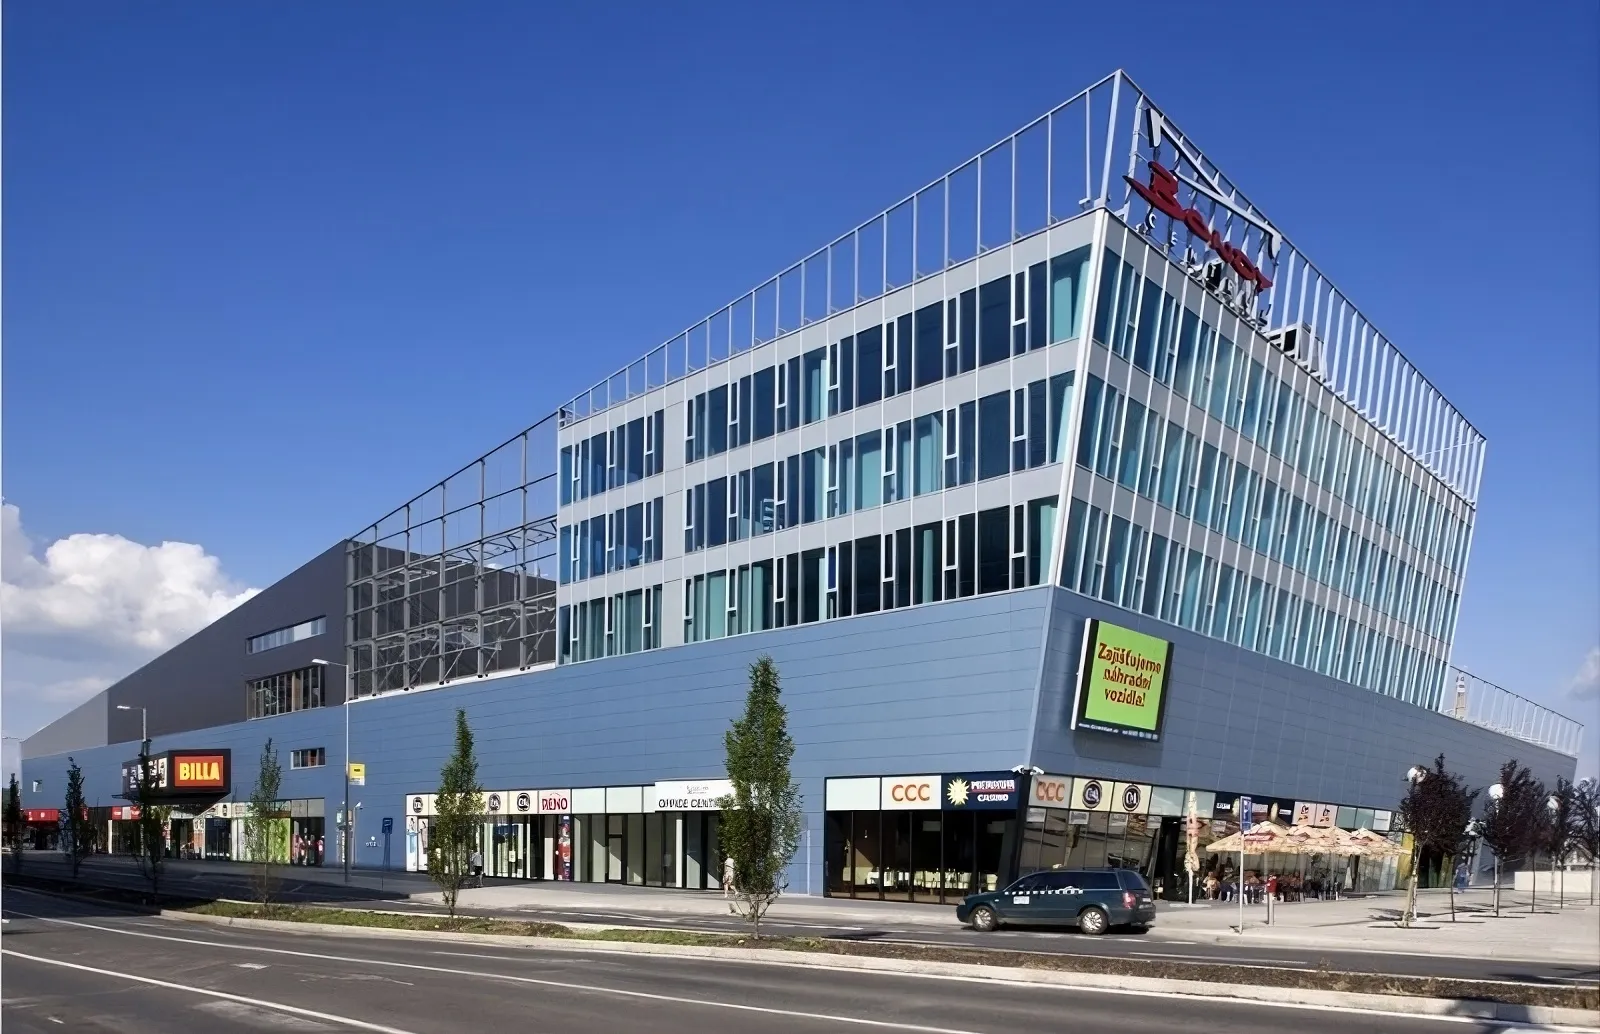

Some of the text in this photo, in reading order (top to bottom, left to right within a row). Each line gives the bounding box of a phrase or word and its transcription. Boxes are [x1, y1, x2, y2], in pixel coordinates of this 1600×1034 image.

[179, 762, 220, 781] BILLA
[891, 783, 931, 802] CCC
[1035, 781, 1066, 802] CCC
